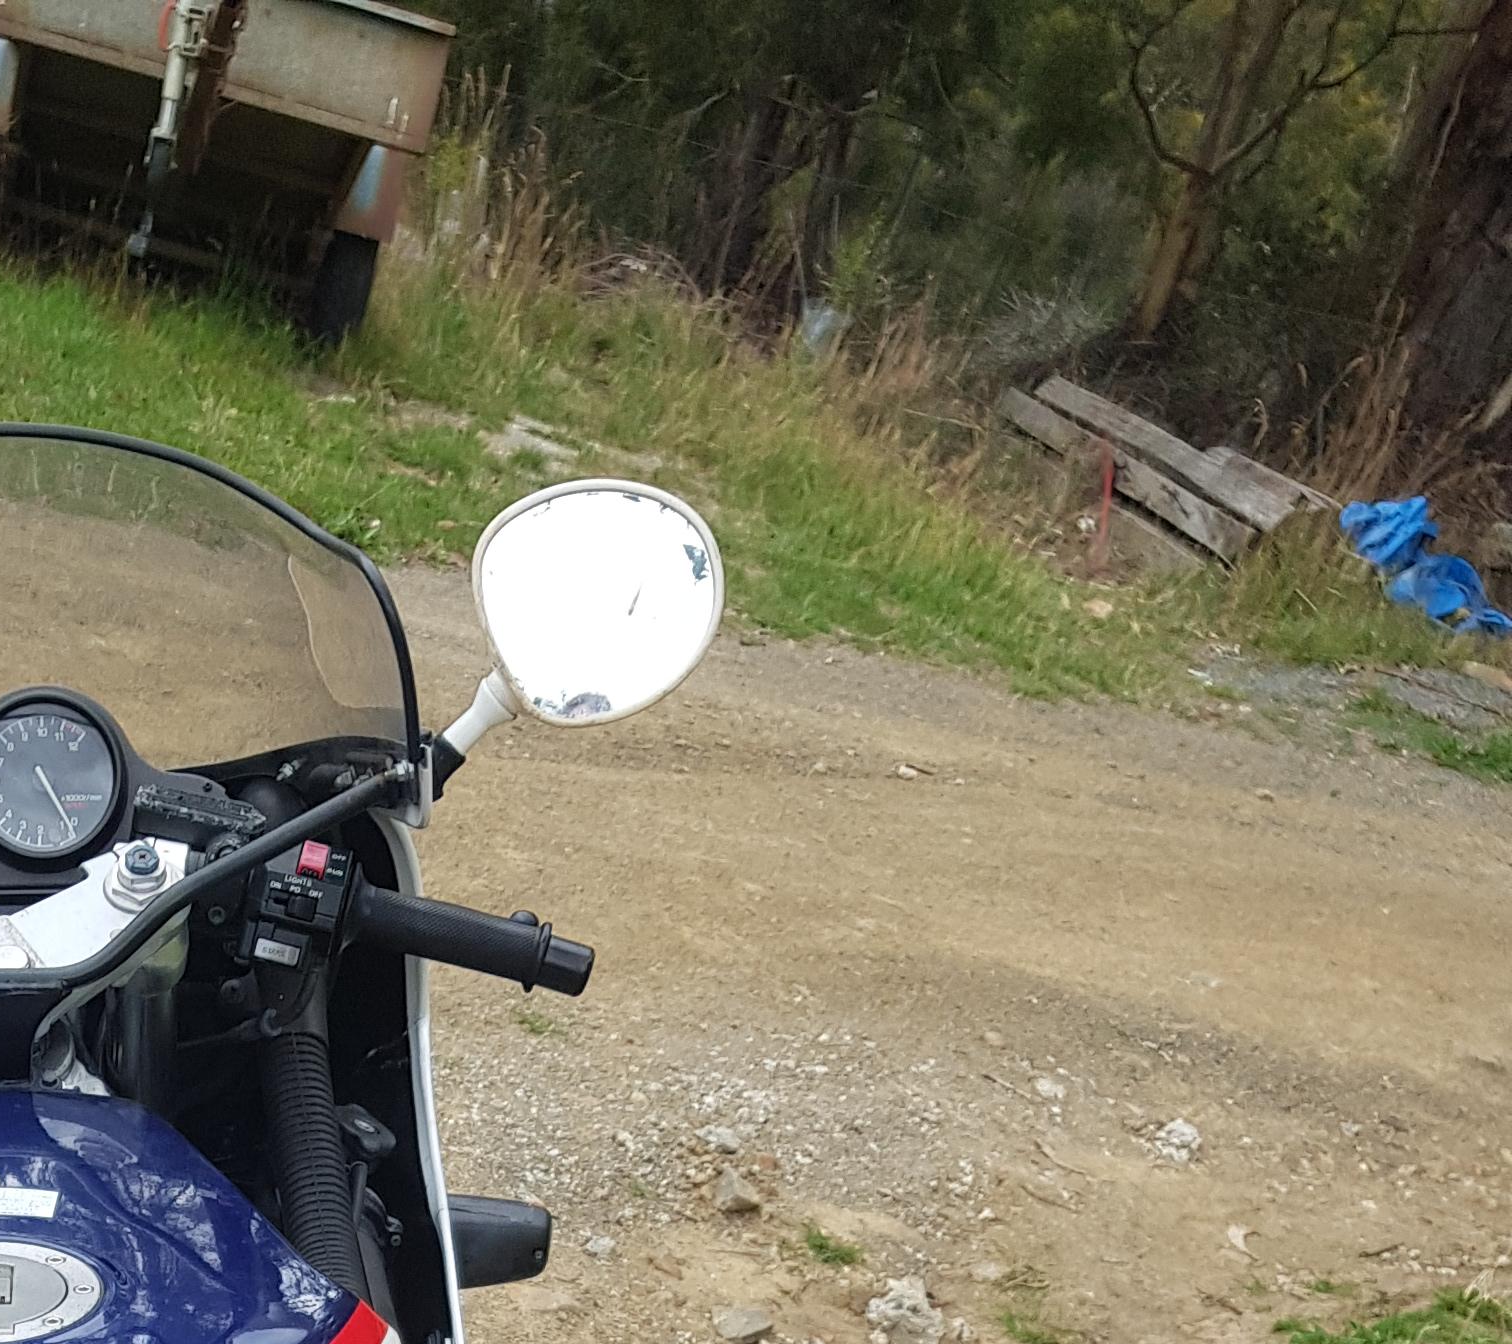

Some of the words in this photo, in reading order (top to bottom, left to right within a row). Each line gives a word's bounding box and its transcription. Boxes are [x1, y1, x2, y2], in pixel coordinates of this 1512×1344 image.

[21, 732, 28, 742] 9
[37, 728, 48, 738] 10
[55, 732, 64, 741] 11
[7, 742, 14, 752] 8
[68, 741, 79, 751] 12
[6, 809, 13, 818] 4
[20, 820, 27, 830] 3
[71, 817, 78, 826] 0
[37, 825, 44, 835] 2
[309, 889, 324, 899] OFF
